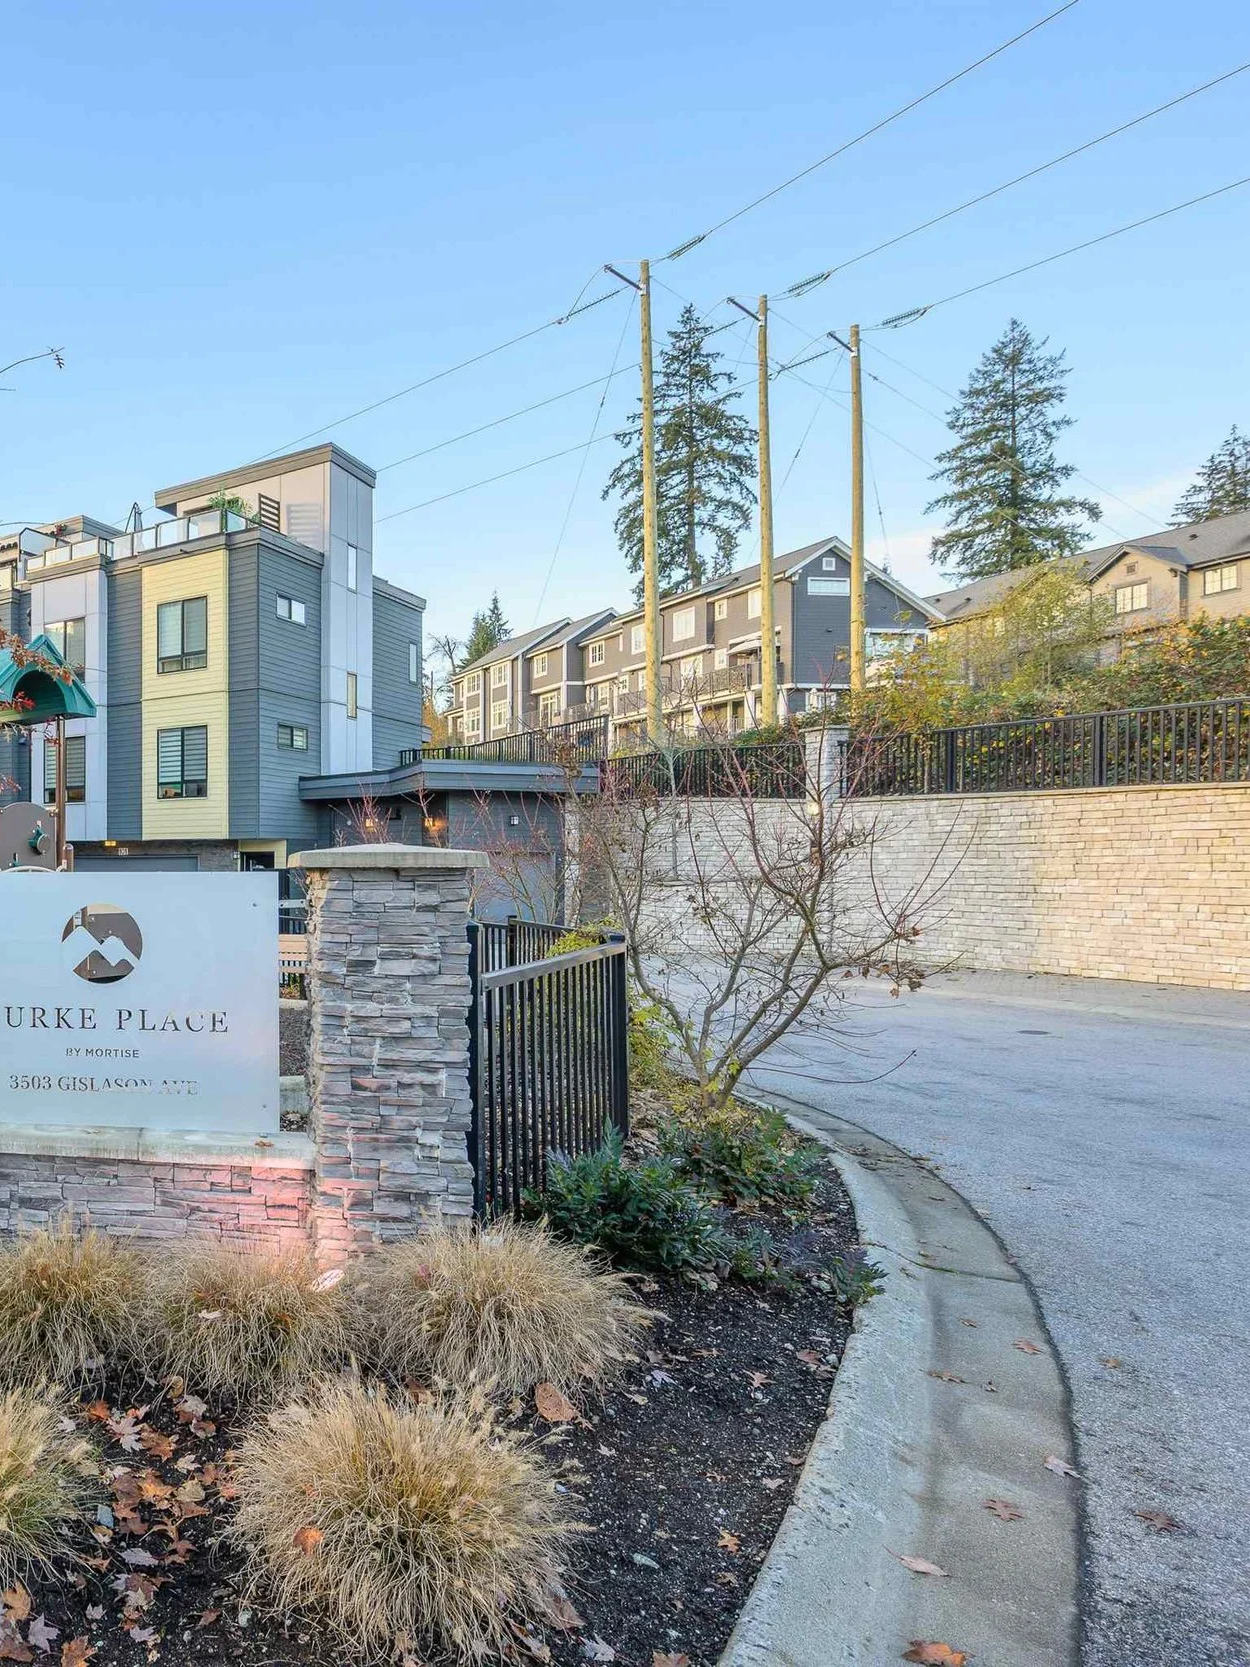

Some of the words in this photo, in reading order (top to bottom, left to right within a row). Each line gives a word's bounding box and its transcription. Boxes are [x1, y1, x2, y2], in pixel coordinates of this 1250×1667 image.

[116, 1007, 229, 1034] PLACE
[65, 1047, 82, 1057] BY
[85, 1048, 140, 1059] MORTISE
[9, 1074, 52, 1091] 3503
